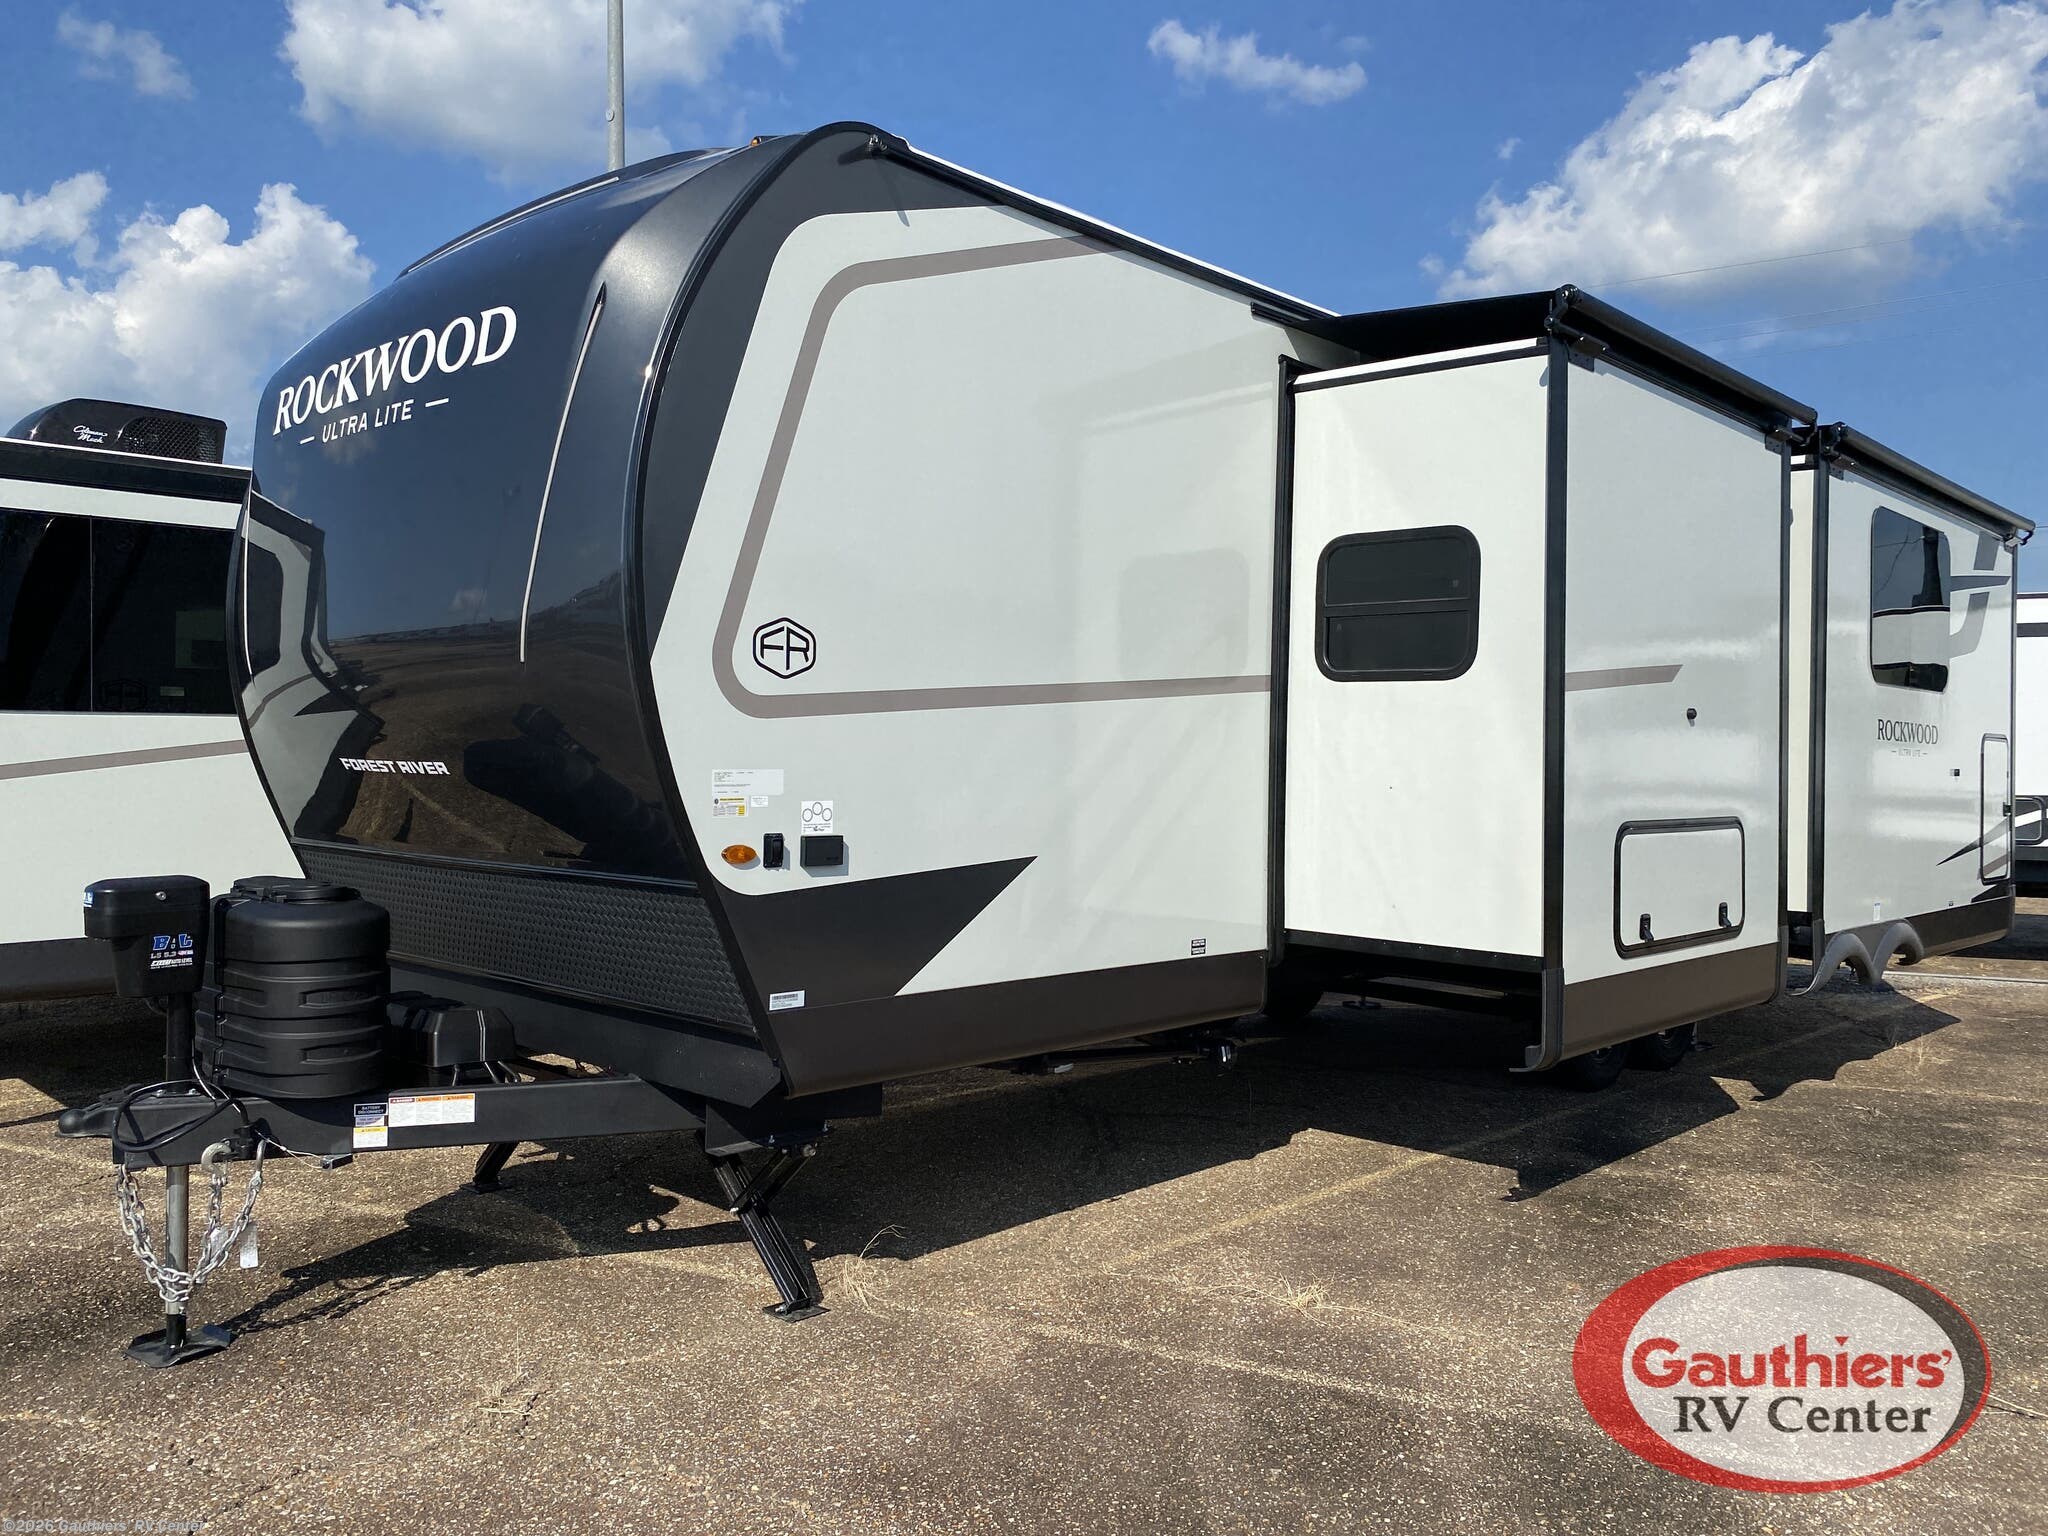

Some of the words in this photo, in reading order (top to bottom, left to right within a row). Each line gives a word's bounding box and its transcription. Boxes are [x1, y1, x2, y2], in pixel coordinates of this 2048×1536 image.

[272, 305, 518, 437] ROCKWOOD
[322, 412, 368, 444] ULTRA
[374, 399, 415, 428] LITE
[1877, 718, 1939, 745] ROCKWOOD
[339, 757, 397, 774] FOREST
[396, 760, 451, 775] RIVER
